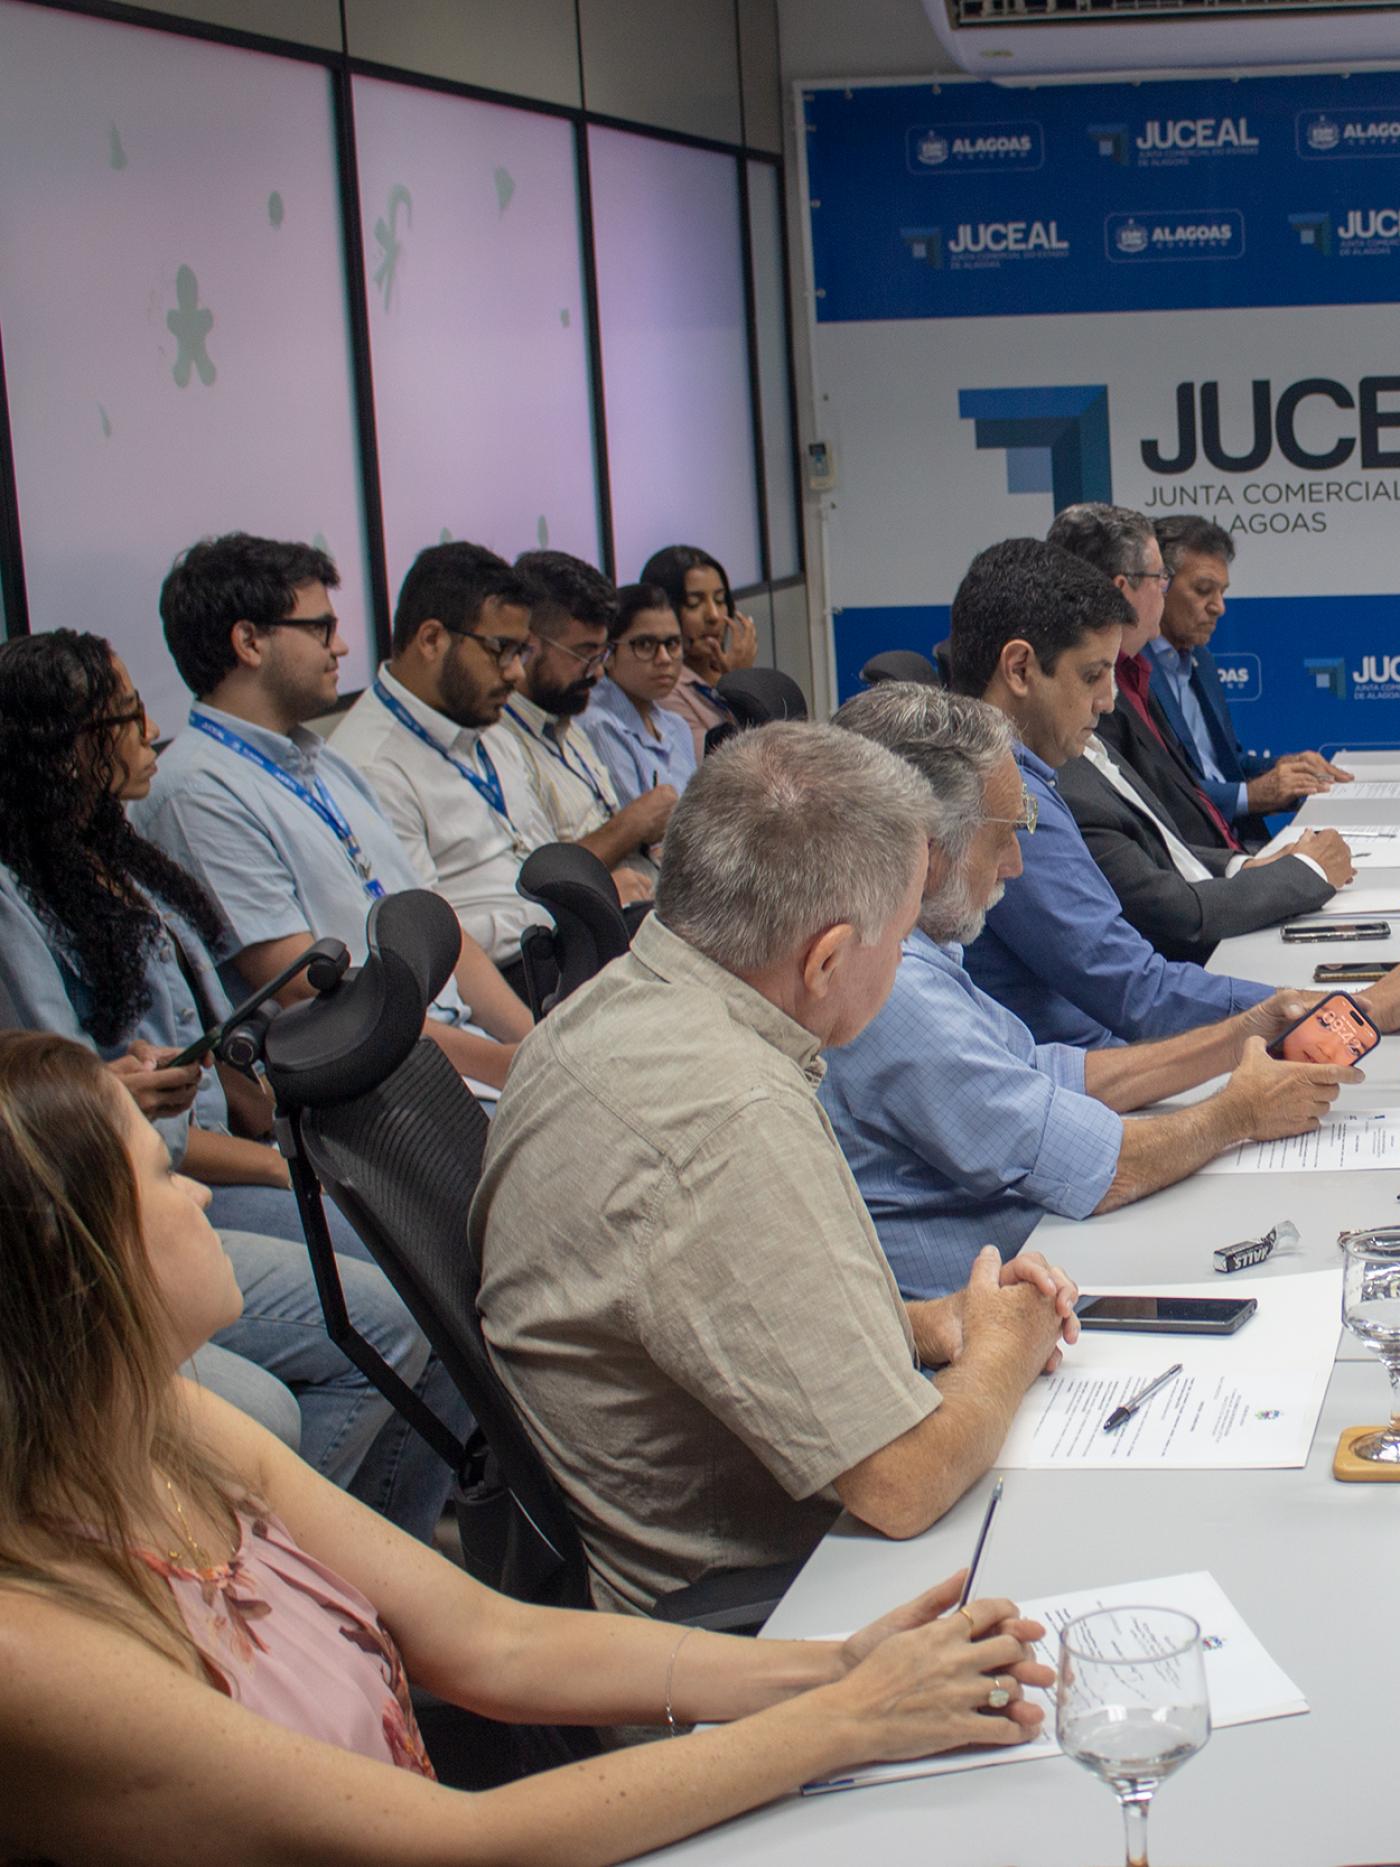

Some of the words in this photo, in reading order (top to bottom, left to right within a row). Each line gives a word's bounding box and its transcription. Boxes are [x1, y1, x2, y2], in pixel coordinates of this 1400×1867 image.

[952, 135, 1032, 153] ALAGOAS
[1136, 118, 1259, 149] JUCEAL
[948, 220, 1069, 253] JUCEAL
[1151, 224, 1232, 241] ALAGOAS
[1145, 484, 1234, 507] JUNTA
[1212, 512, 1327, 534] AGOAS
